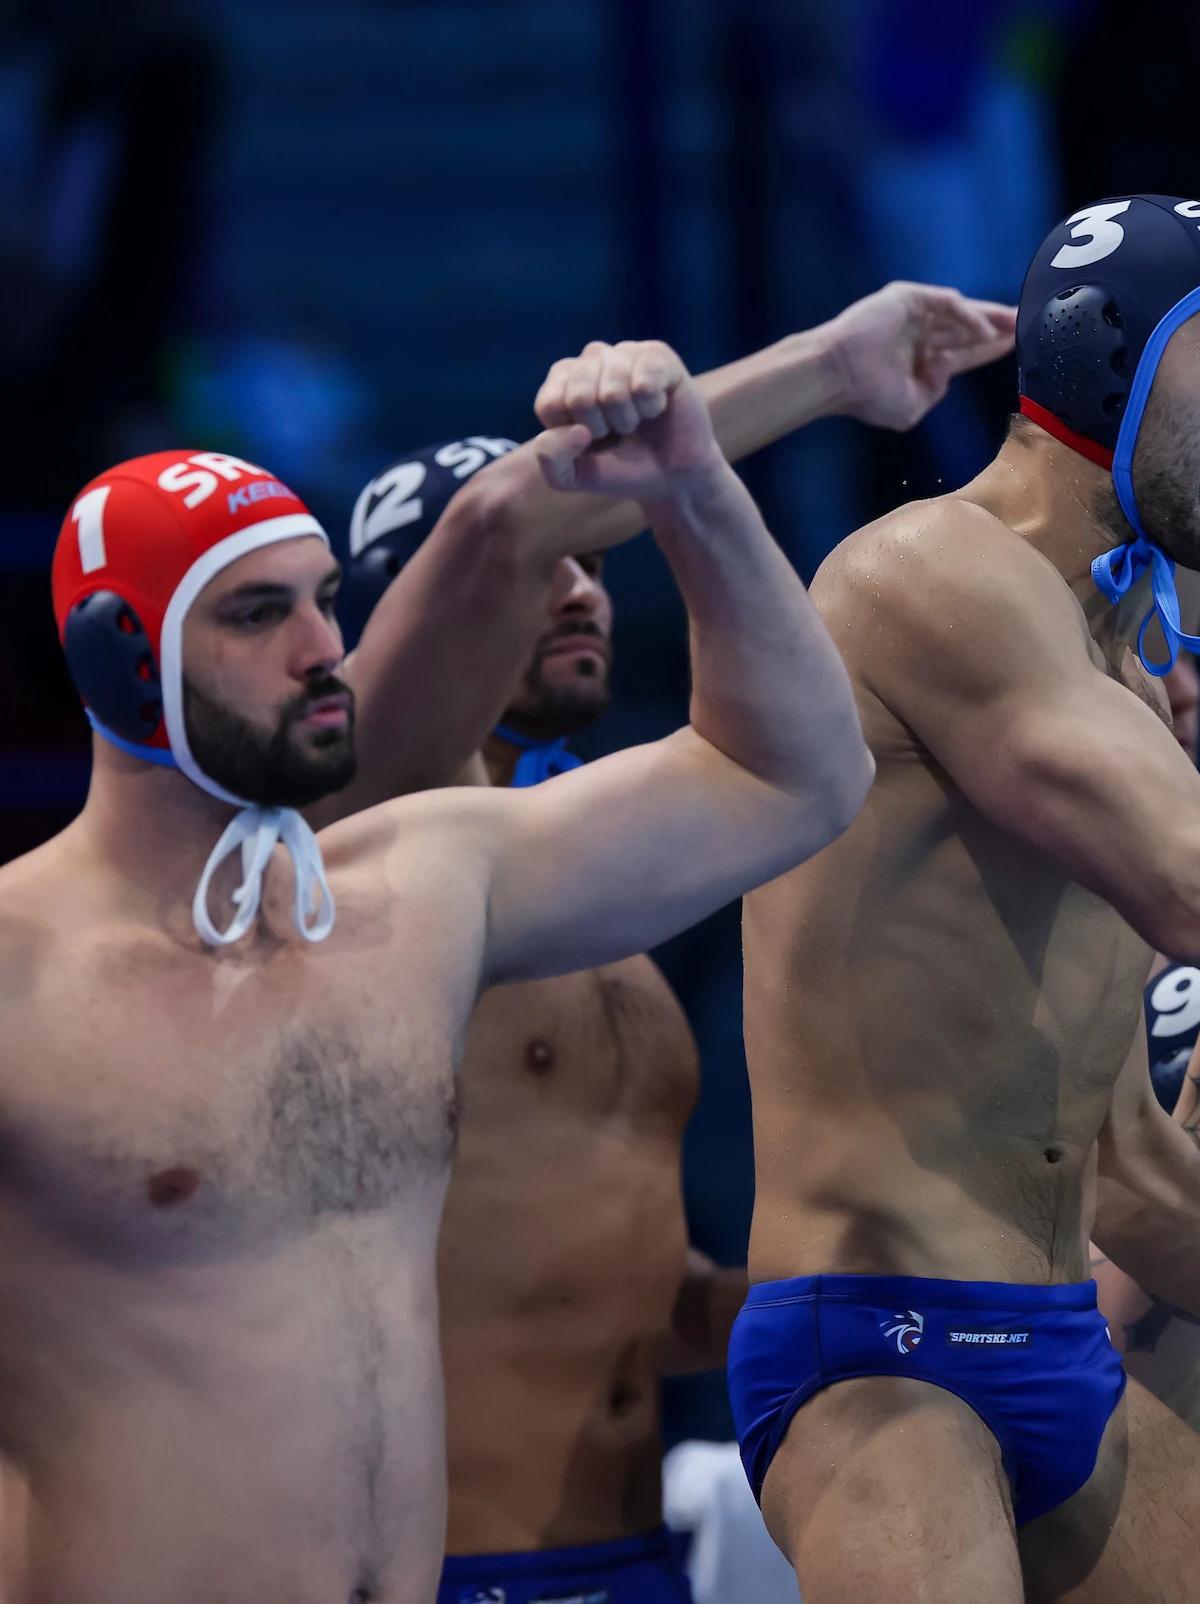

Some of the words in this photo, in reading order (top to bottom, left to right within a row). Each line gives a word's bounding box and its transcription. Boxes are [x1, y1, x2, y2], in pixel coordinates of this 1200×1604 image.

[1050, 200, 1132, 268] 3
[158, 452, 276, 509] SR
[349, 461, 427, 559] 12
[71, 485, 111, 574] 1
